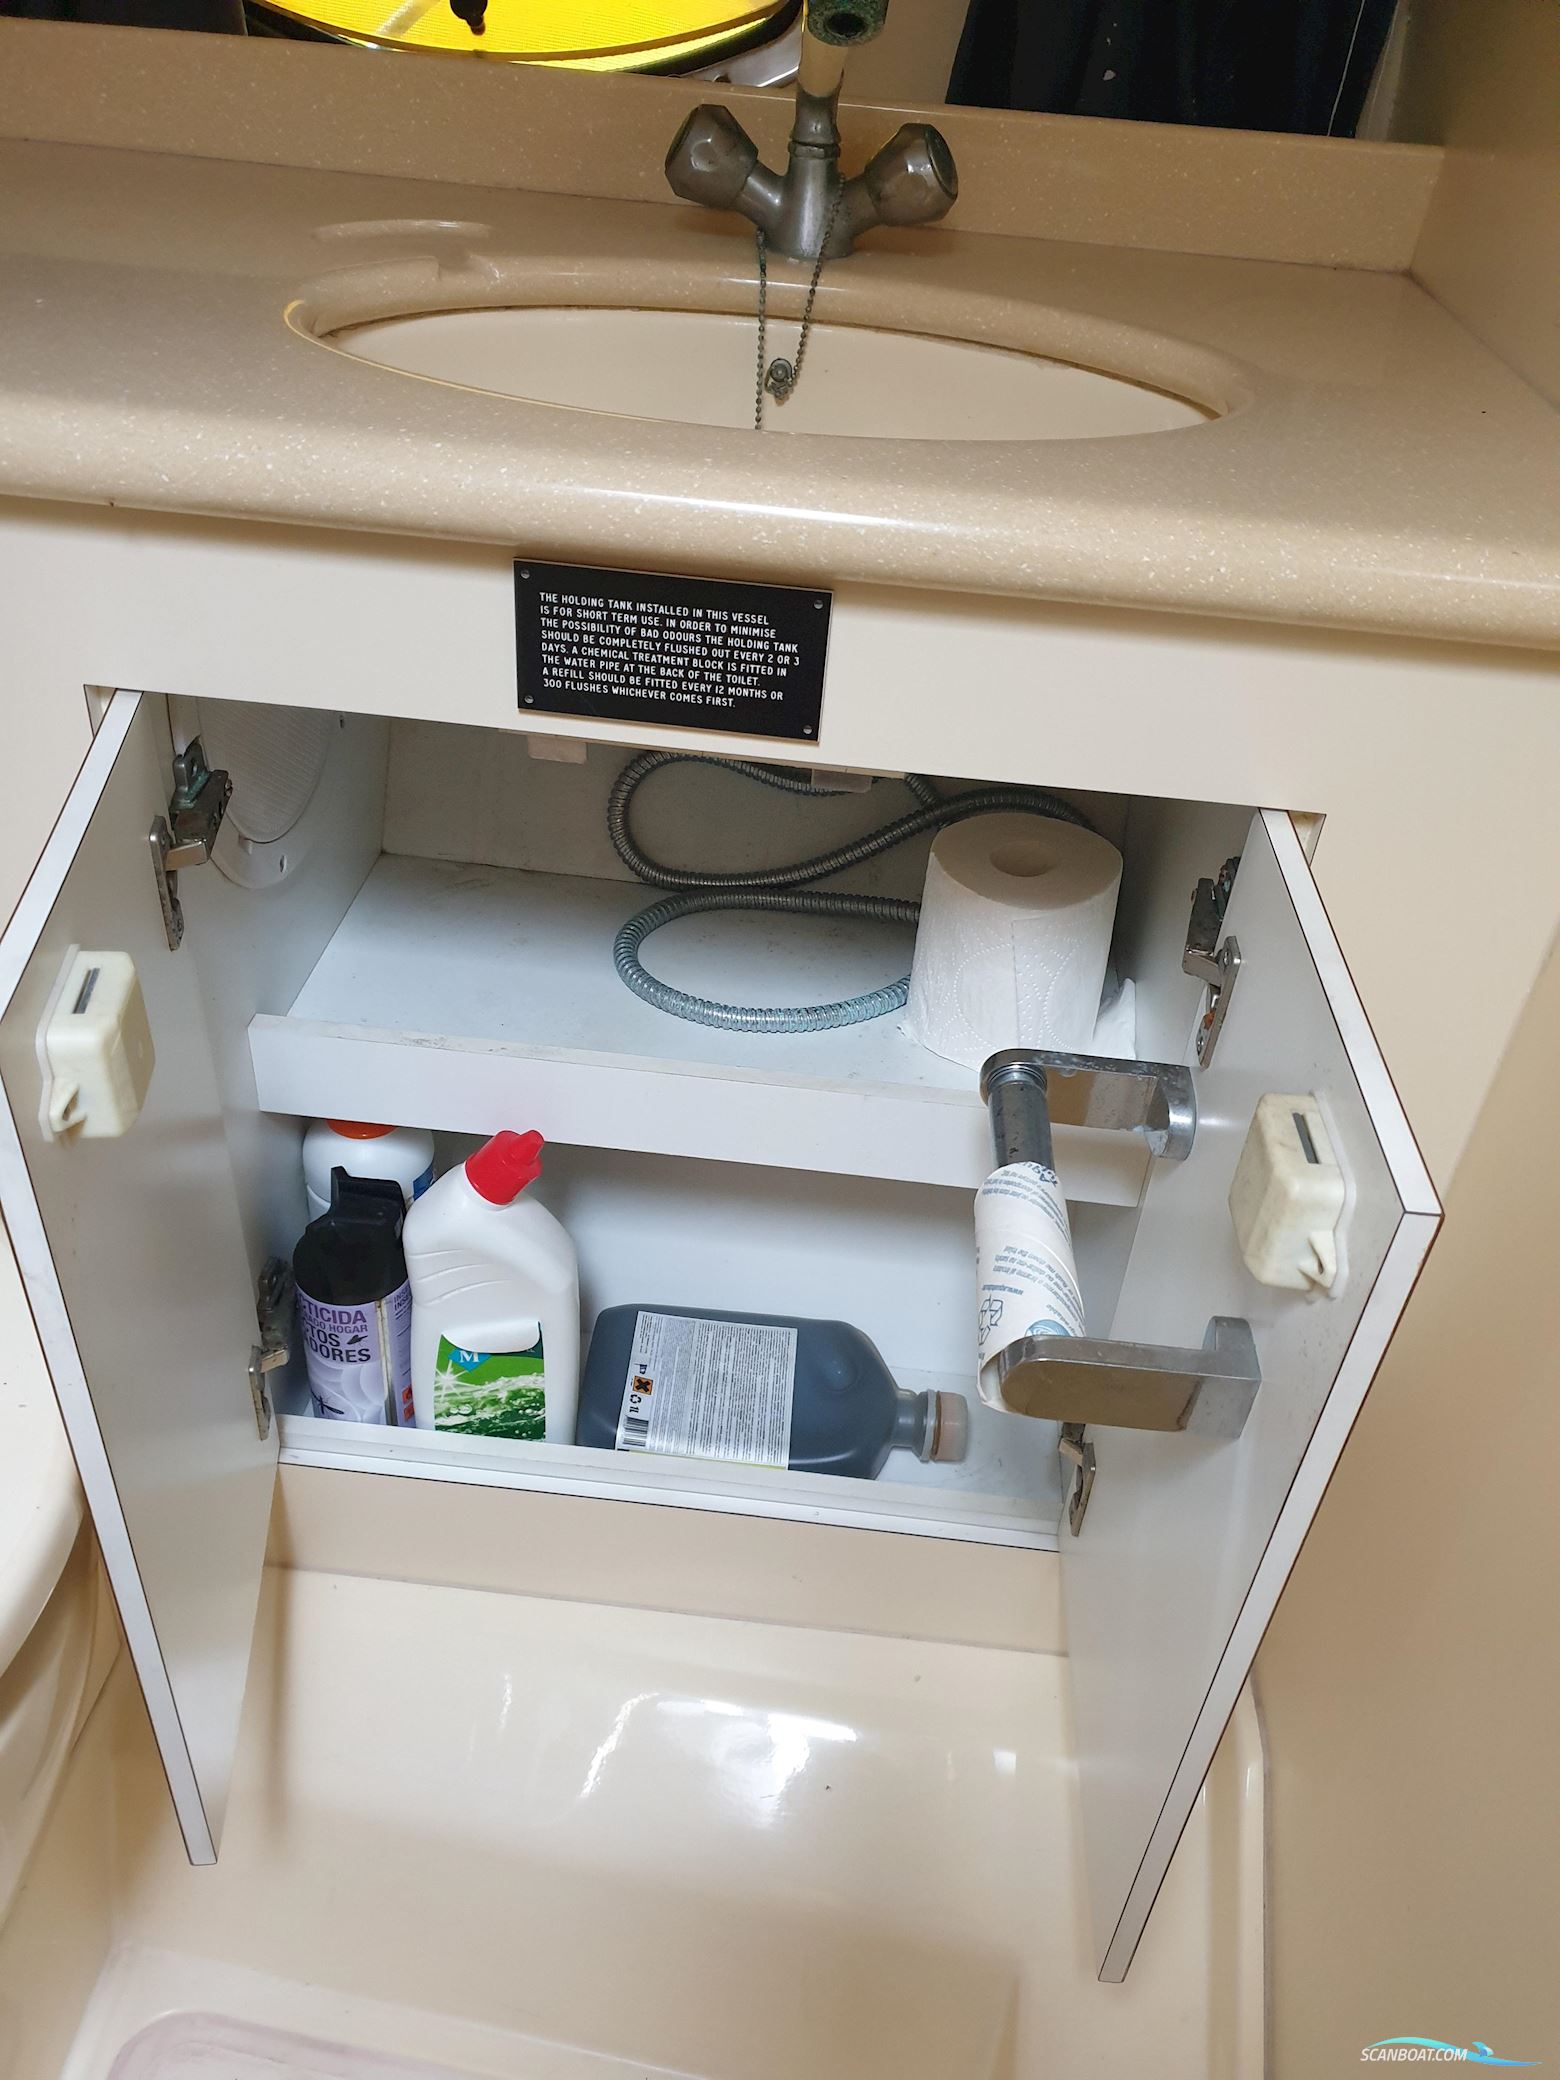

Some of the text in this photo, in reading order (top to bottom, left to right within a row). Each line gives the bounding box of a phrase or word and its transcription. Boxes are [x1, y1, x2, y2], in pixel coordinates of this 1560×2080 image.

[539, 592, 769, 626] THE HOLDING TANK INSTALLED IN THIS VESSEL
[540, 605, 777, 639] IS FOR SHORT TERM USE. IN ORDER TO MINIMISE
[540, 617, 798, 653] THE POSSIBILITY OF BAD ODOURS THE HOLDING TANK
[541, 629, 800, 666] SHOULD BE COMPLETELY FLUSHED OUT EVERY 2 OR 3
[541, 641, 787, 677] DAYS. A CHEMICAL TREATMENT BLOCK IS FITTED IN
[541, 653, 760, 686] THE WATER PIPE AT THE BACK OF THE TOILET.
[542, 666, 783, 701] A REFILL SHOULD BE FITTED EVERY 12 MONTHS OR
[543, 678, 736, 708] 300 FLUSHES WHICHEVER COMES FIRST.
[329, 1323, 369, 1335] HOGAR
